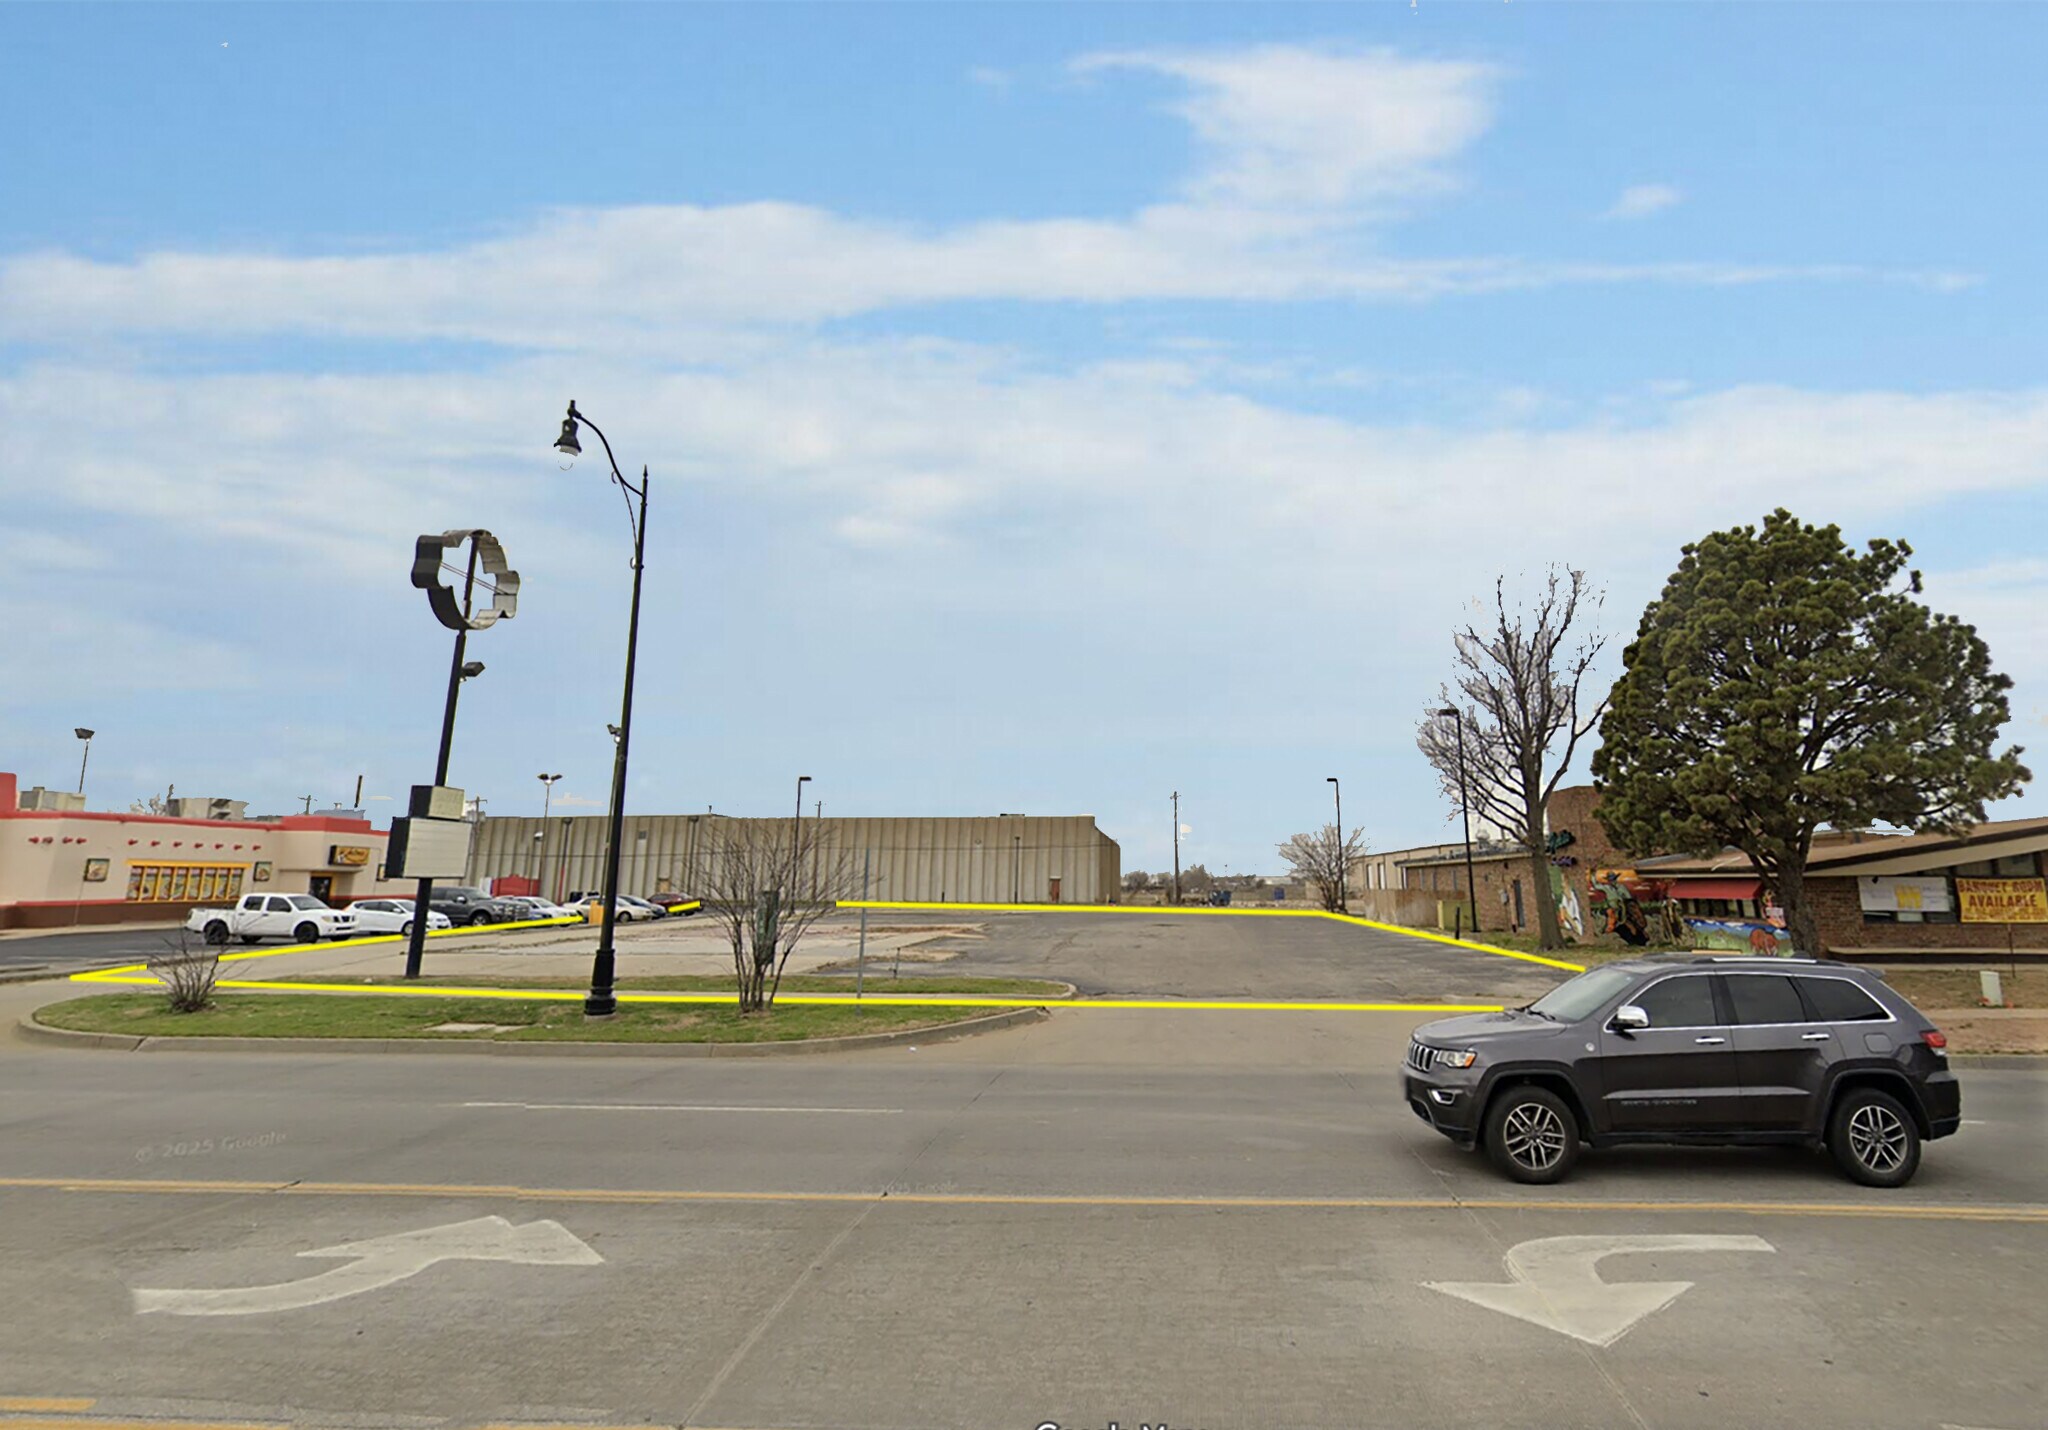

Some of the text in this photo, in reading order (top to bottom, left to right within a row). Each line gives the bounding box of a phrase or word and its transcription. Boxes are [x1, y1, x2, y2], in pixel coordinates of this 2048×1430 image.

[1957, 880, 2044, 893] BANQUET ROOM
[1968, 895, 2038, 907] AVAILABLE
